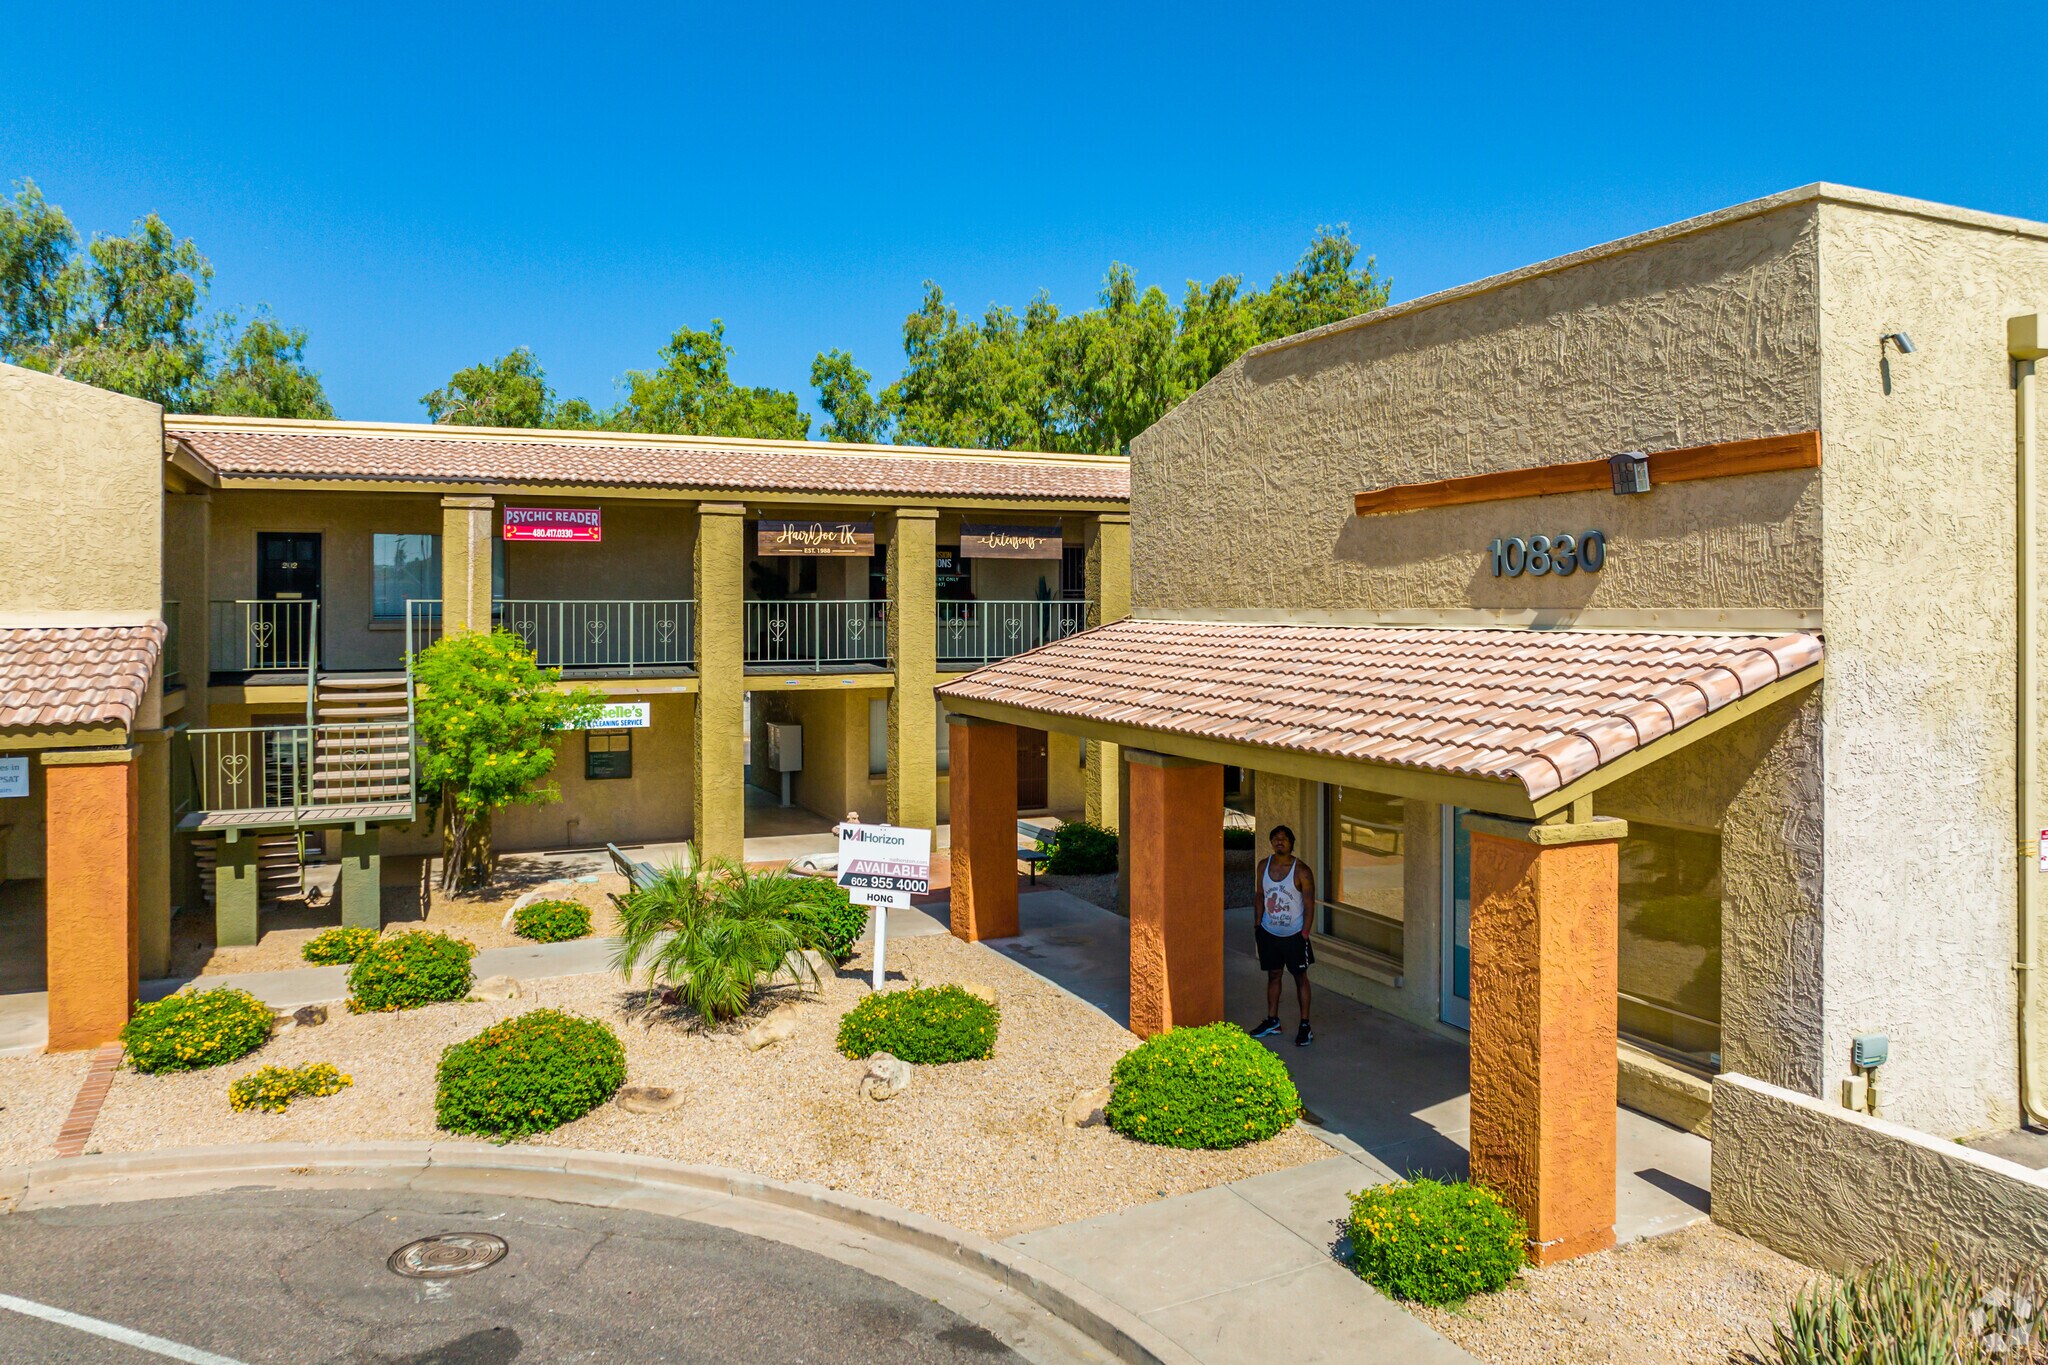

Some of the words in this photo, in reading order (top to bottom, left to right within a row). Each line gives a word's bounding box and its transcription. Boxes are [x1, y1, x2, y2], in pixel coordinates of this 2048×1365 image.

[506, 510, 553, 525] PSYCHIC
[555, 511, 599, 527] READER
[532, 528, 573, 538] 480.417.0330
[835, 524, 857, 545] TK
[978, 532, 1046, 550] Extensions
[1487, 529, 1606, 577] 10830
[855, 861, 928, 878] AVAILABLE
[851, 877, 868, 886] 602
[871, 876, 893, 889] 955
[896, 879, 927, 892] 4000
[866, 893, 894, 903] HONG
